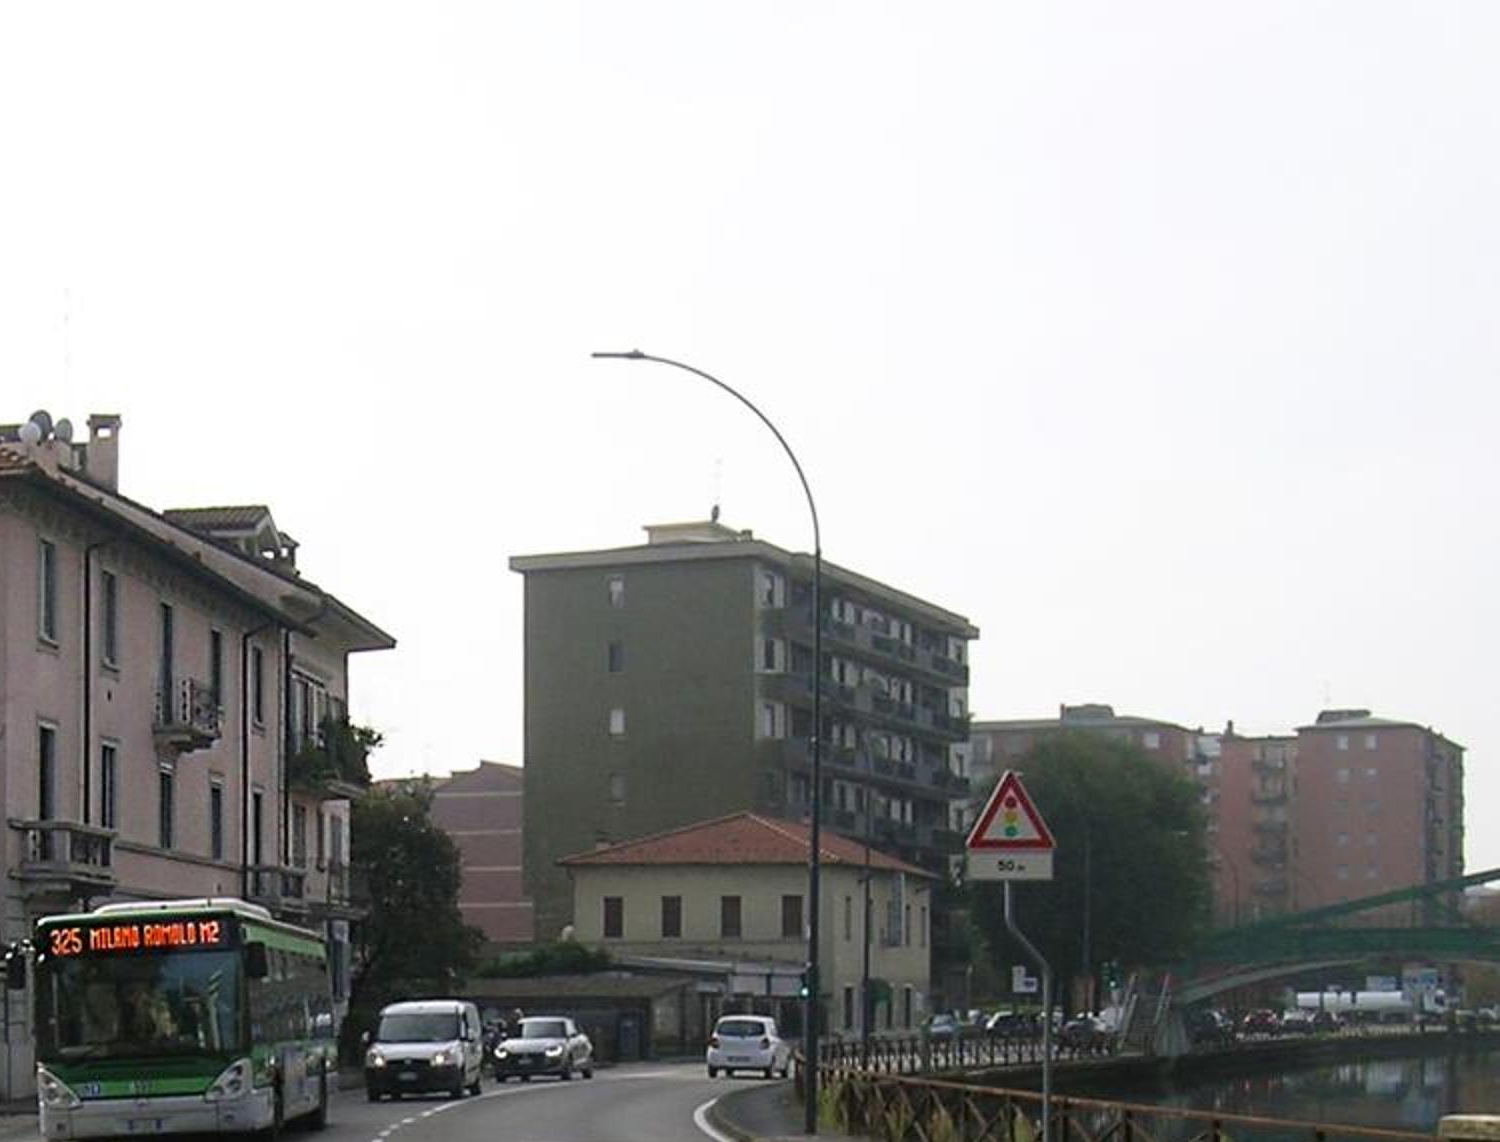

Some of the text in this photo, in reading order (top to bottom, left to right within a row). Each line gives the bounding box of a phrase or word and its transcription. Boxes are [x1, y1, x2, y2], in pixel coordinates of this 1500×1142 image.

[998, 860, 1015, 871] 50
[50, 927, 83, 955] 325
[199, 920, 220, 944] M2
